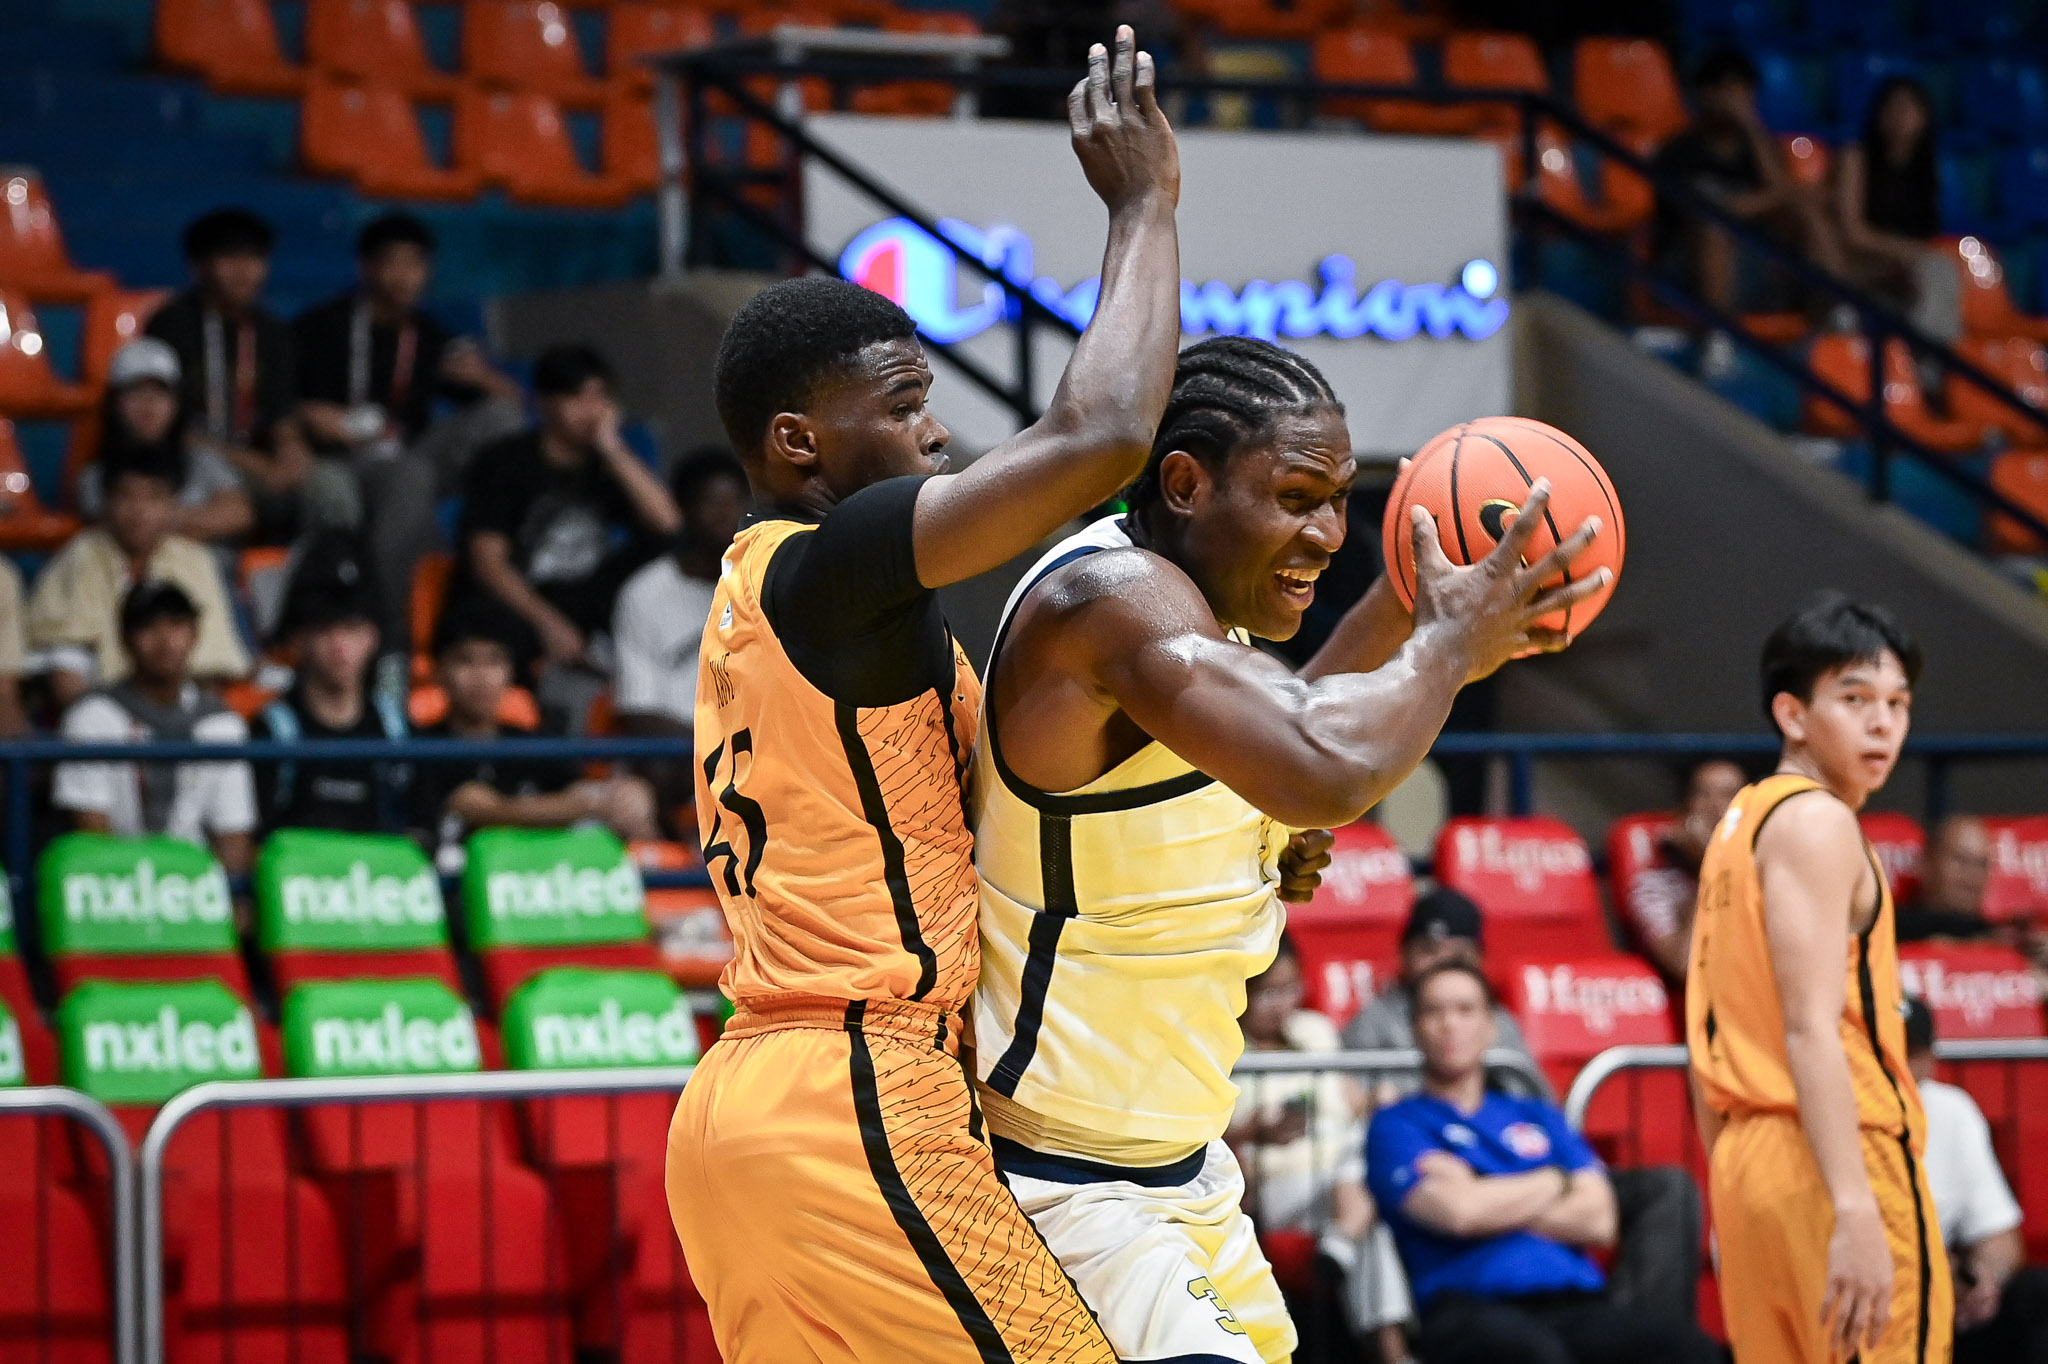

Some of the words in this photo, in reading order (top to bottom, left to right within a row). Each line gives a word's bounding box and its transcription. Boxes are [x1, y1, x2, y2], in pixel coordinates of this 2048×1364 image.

[64, 858, 234, 923] nxled
[282, 860, 443, 923] nxled
[487, 854, 645, 916] nxled
[83, 1003, 260, 1071] nxled
[313, 1001, 480, 1068] nxled
[532, 996, 698, 1066] nxled
[1187, 1276, 1247, 1335] 3
